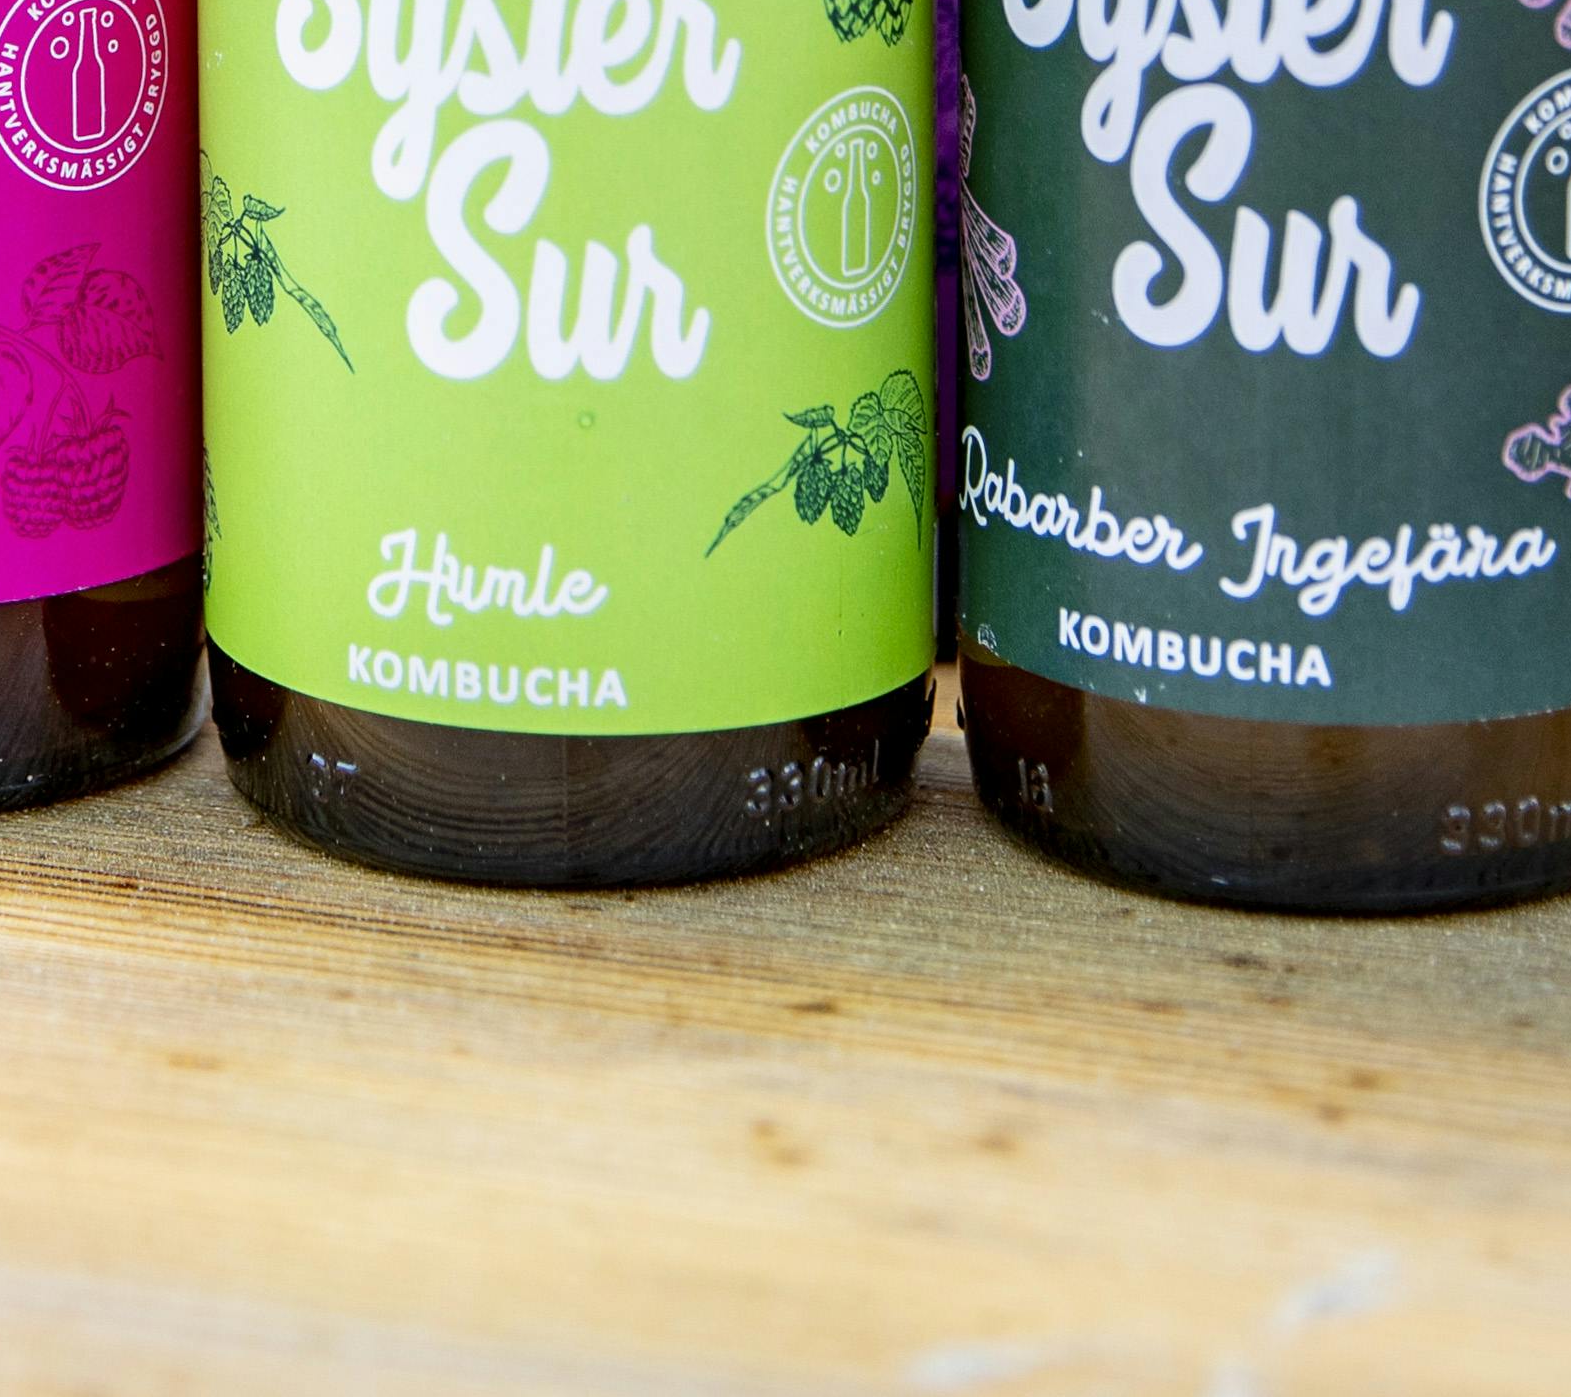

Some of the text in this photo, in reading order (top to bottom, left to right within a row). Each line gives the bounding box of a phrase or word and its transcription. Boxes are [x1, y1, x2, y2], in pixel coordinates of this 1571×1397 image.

[143, 13, 162, 116] BRYGGD
[805, 101, 898, 154] KOMBUCHA
[404, 118, 712, 381] Sur
[776, 176, 899, 316] HANTVERKSMÄSSIGT
[1111, 81, 1423, 359] Sur
[959, 424, 1557, 616] Rabarber Ingefära
[366, 528, 609, 626] Humle
[348, 641, 629, 707] KOMBUCHA
[1057, 606, 1334, 687] KOMBUCHA
